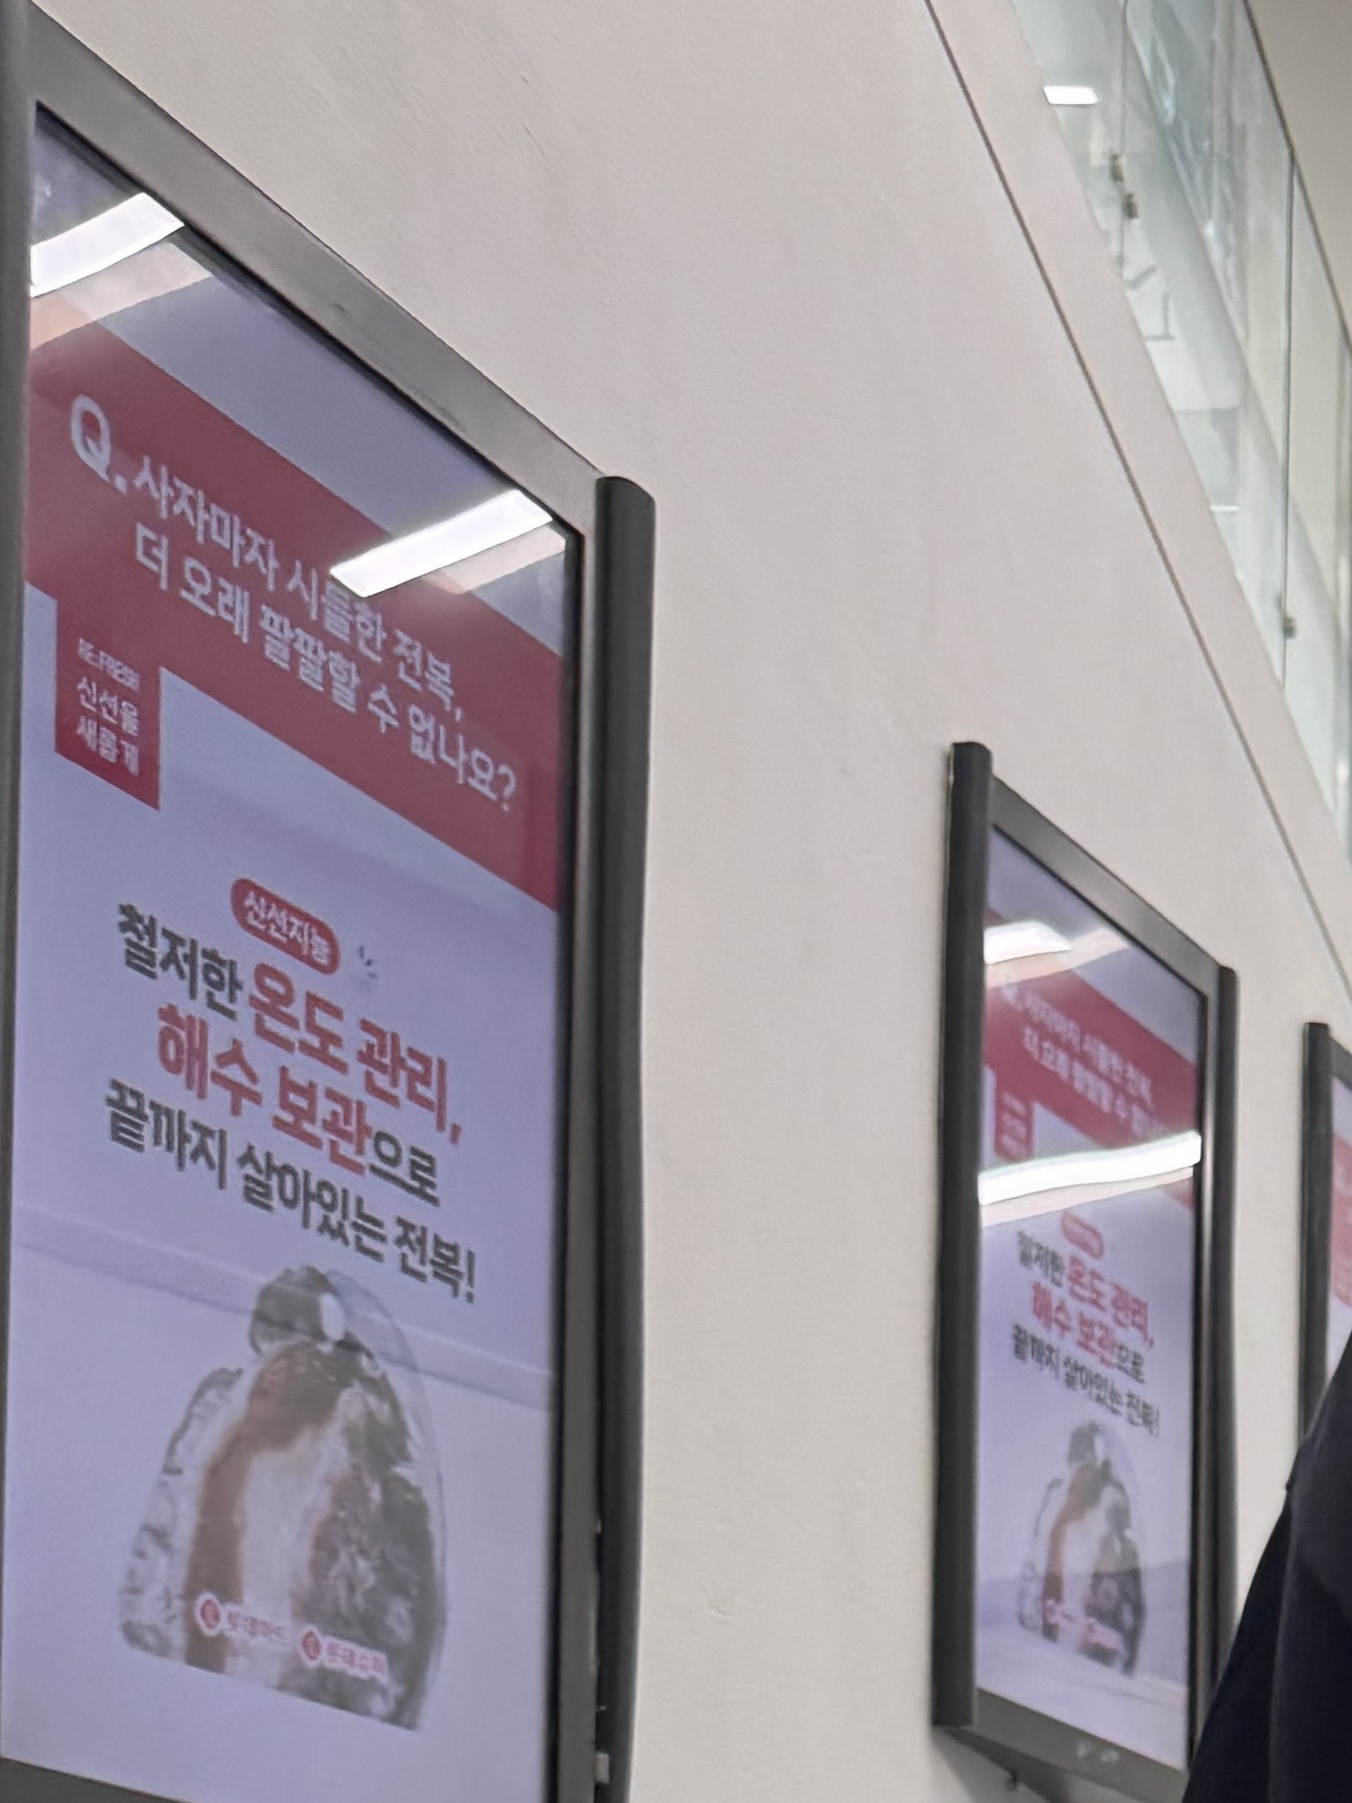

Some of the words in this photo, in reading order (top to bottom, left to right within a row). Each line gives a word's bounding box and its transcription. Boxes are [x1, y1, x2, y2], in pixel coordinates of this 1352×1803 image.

[134, 525, 170, 591] 더
[179, 558, 250, 644] 오래
[260, 598, 362, 714] 팔팔할
[367, 679, 400, 734] 수
[408, 703, 518, 814] 없나요?
[286, 557, 388, 664] 시들한
[393, 628, 463, 721] 전복,
[117, 902, 244, 1021] 철저한
[247, 962, 350, 1076] 온도
[356, 1017, 463, 1146] 관리,
[156, 1002, 264, 1119] 해수
[271, 1064, 441, 1208] 보관으로
[105, 1078, 228, 1191] 끝까지
[236, 1142, 388, 1263] 살아있는
[393, 1215, 477, 1305] 전복!
